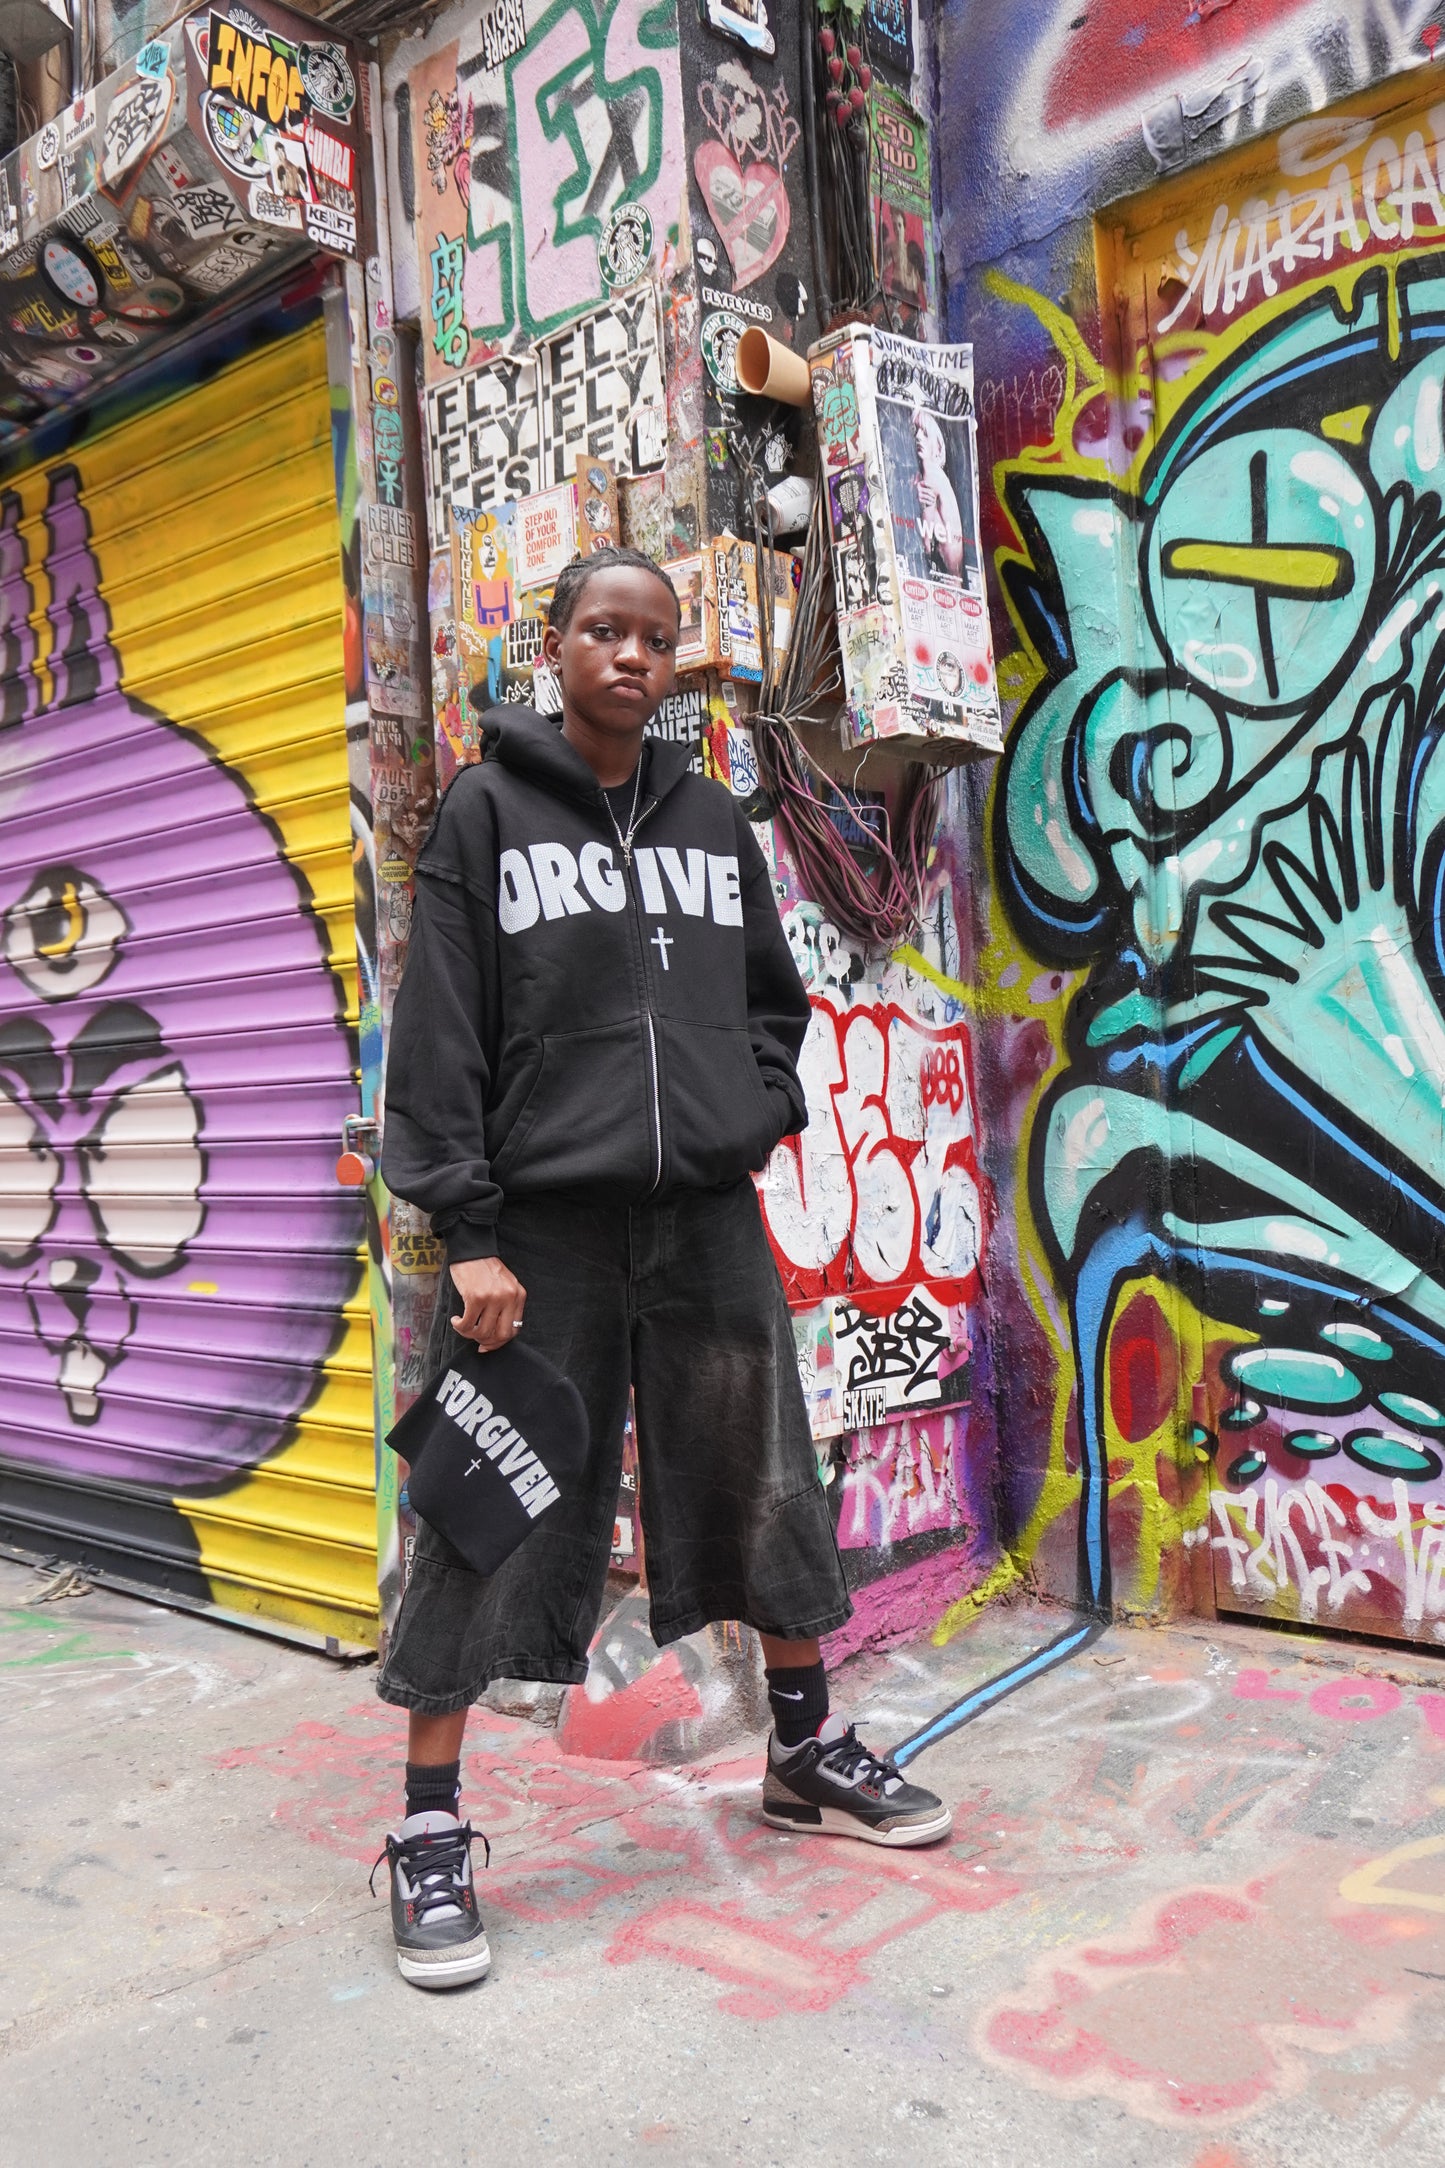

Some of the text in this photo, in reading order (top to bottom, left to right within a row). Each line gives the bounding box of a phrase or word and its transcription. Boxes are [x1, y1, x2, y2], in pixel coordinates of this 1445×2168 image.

[615, 205, 647, 223] DEFEND
[307, 227, 355, 255] QUEFT
[600, 224, 615, 256] DENY
[704, 287, 773, 321] FLYFLYLES
[551, 291, 653, 386] FLY
[873, 330, 972, 370] SUMMERTIME
[436, 360, 523, 436] FLY
[438, 404, 531, 487] FLY
[525, 513, 543, 529] STEP
[525, 522, 557, 542] OF YOUR
[526, 533, 562, 555] COMFORT
[526, 552, 546, 568] ZONE
[717, 554, 730, 653] FLYFLYLES
[659, 691, 700, 722] VEGAN
[843, 1388, 887, 1431] SKATE!
[435, 1368, 562, 1520] FORGIVEN
